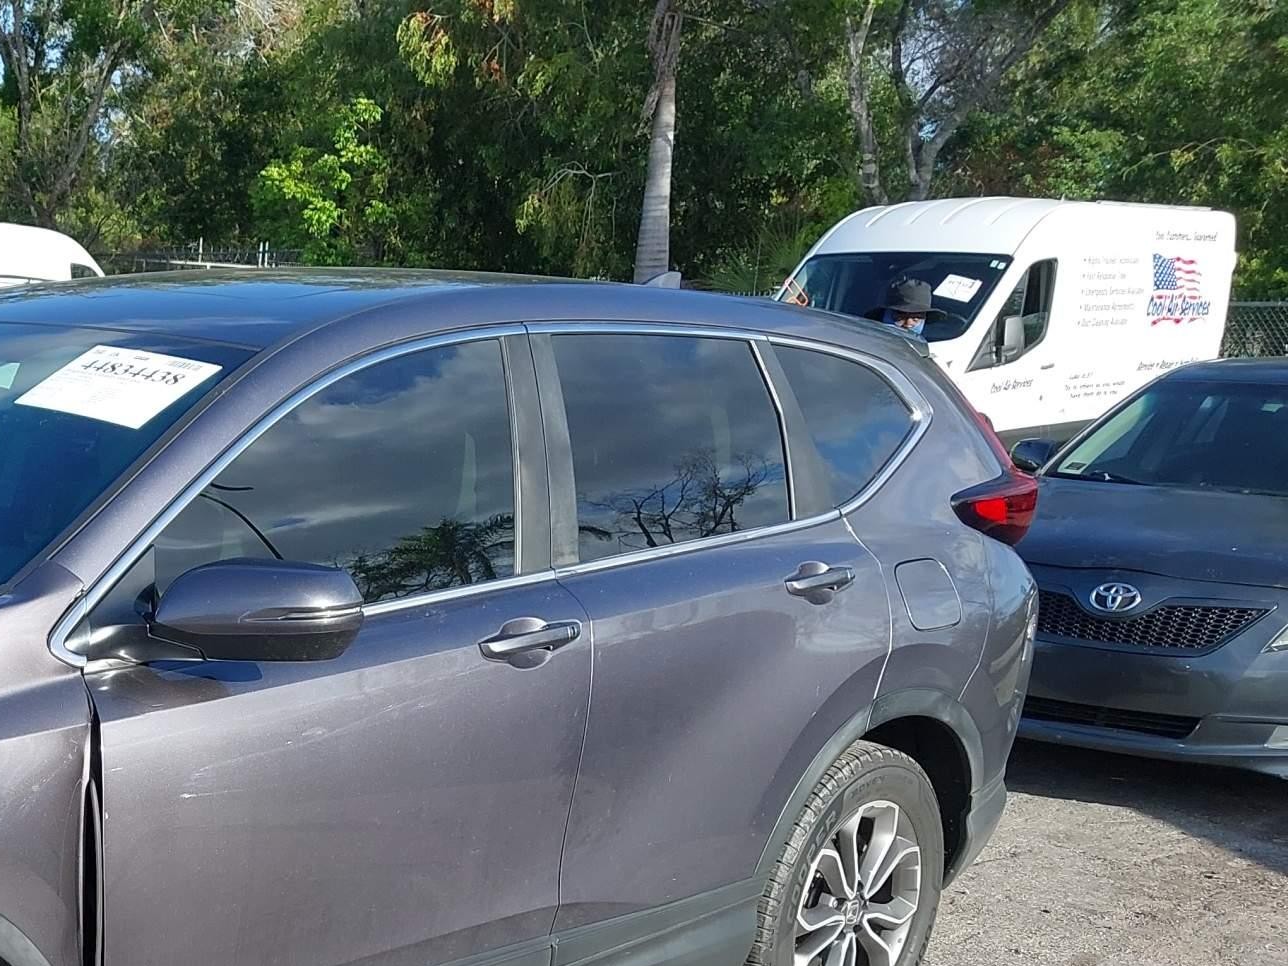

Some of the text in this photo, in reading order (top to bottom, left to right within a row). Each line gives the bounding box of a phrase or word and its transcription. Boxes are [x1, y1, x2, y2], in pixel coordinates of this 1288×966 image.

[1147, 295, 1166, 316] Cool
[1179, 295, 1211, 316] Services
[81, 360, 186, 385] 44834438
[787, 810, 837, 925] COOPER
